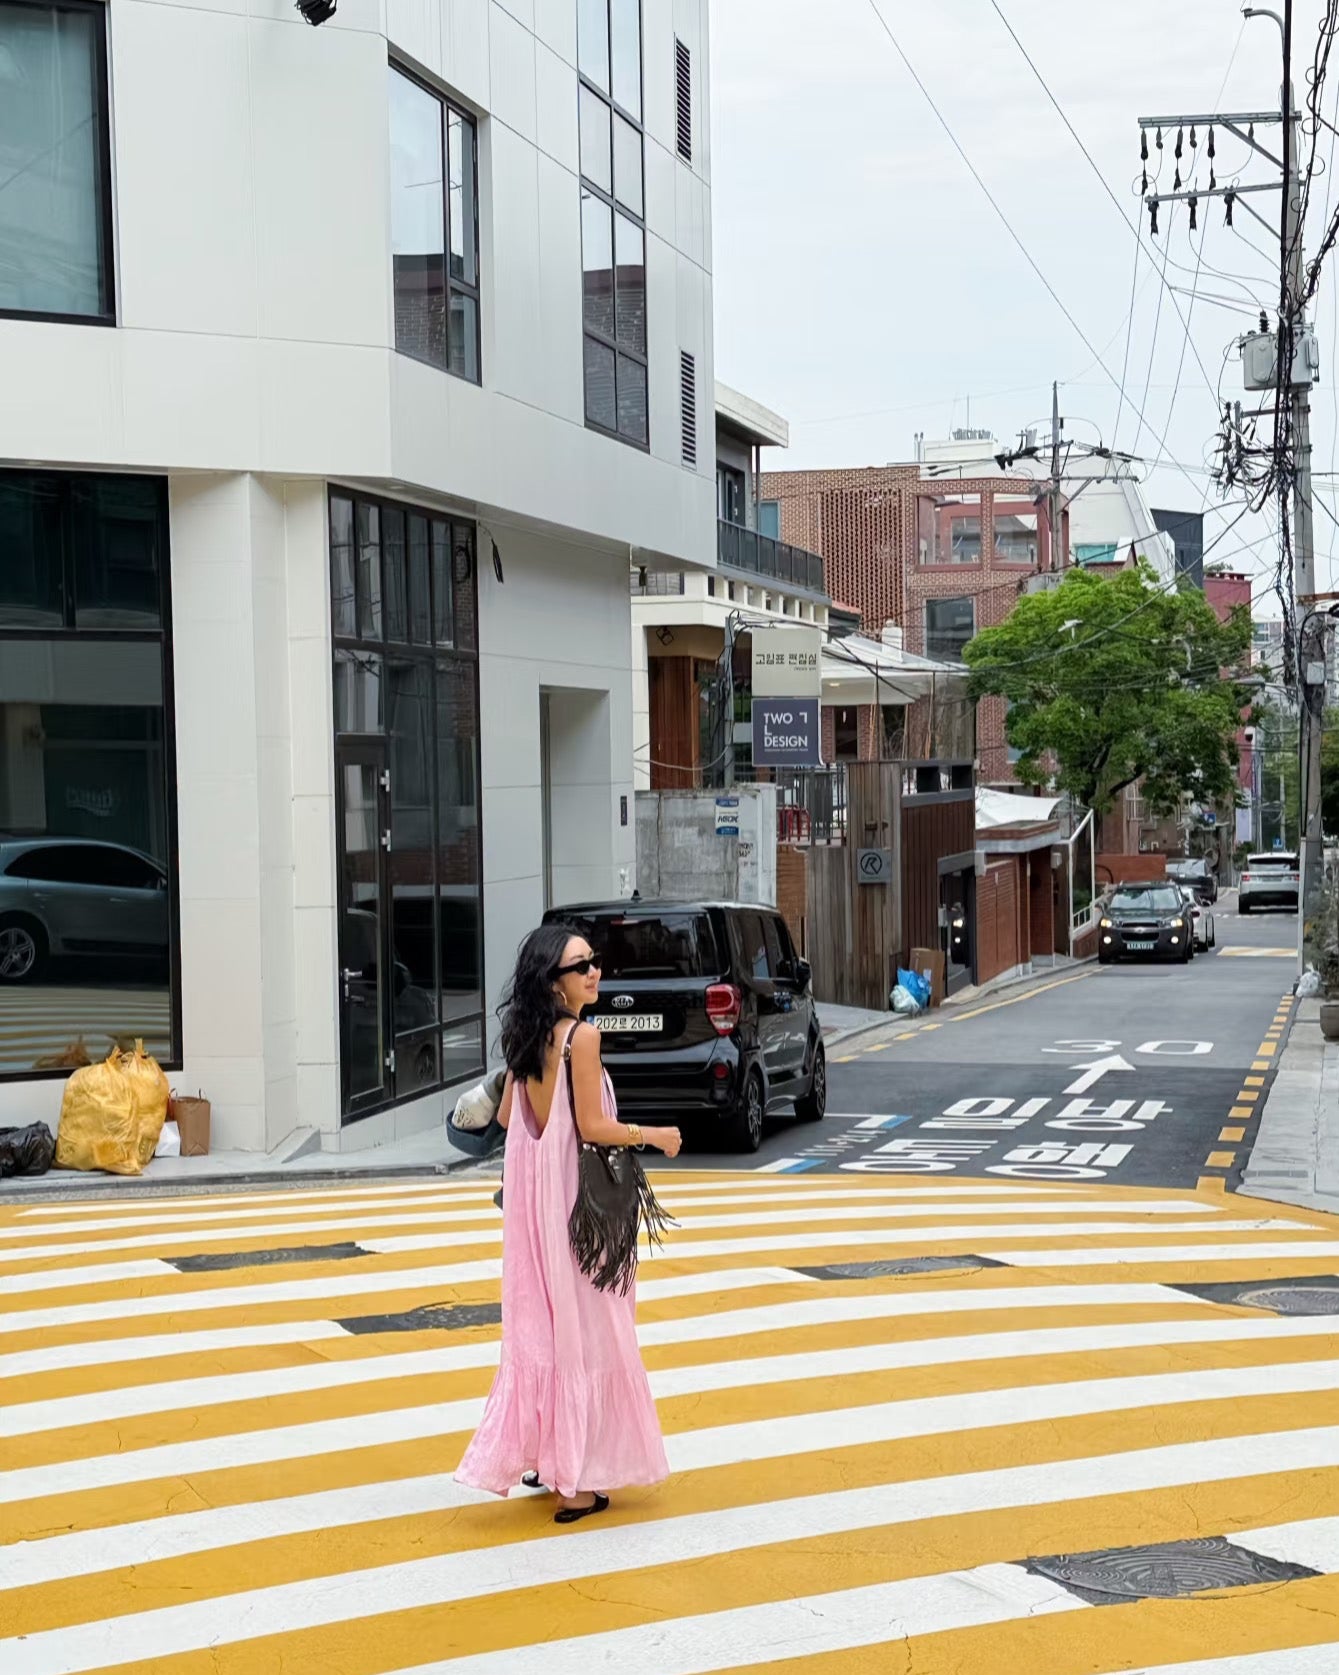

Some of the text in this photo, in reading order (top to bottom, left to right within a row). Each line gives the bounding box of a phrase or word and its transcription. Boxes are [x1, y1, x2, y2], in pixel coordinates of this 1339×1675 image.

[763, 712, 793, 725] TWO
[764, 735, 808, 747] DESIGN
[630, 1016, 660, 1029] 2013
[1041, 1039, 1215, 1055] 30
[918, 1096, 1174, 1131] 일방
[837, 1139, 1134, 1179] 통행
